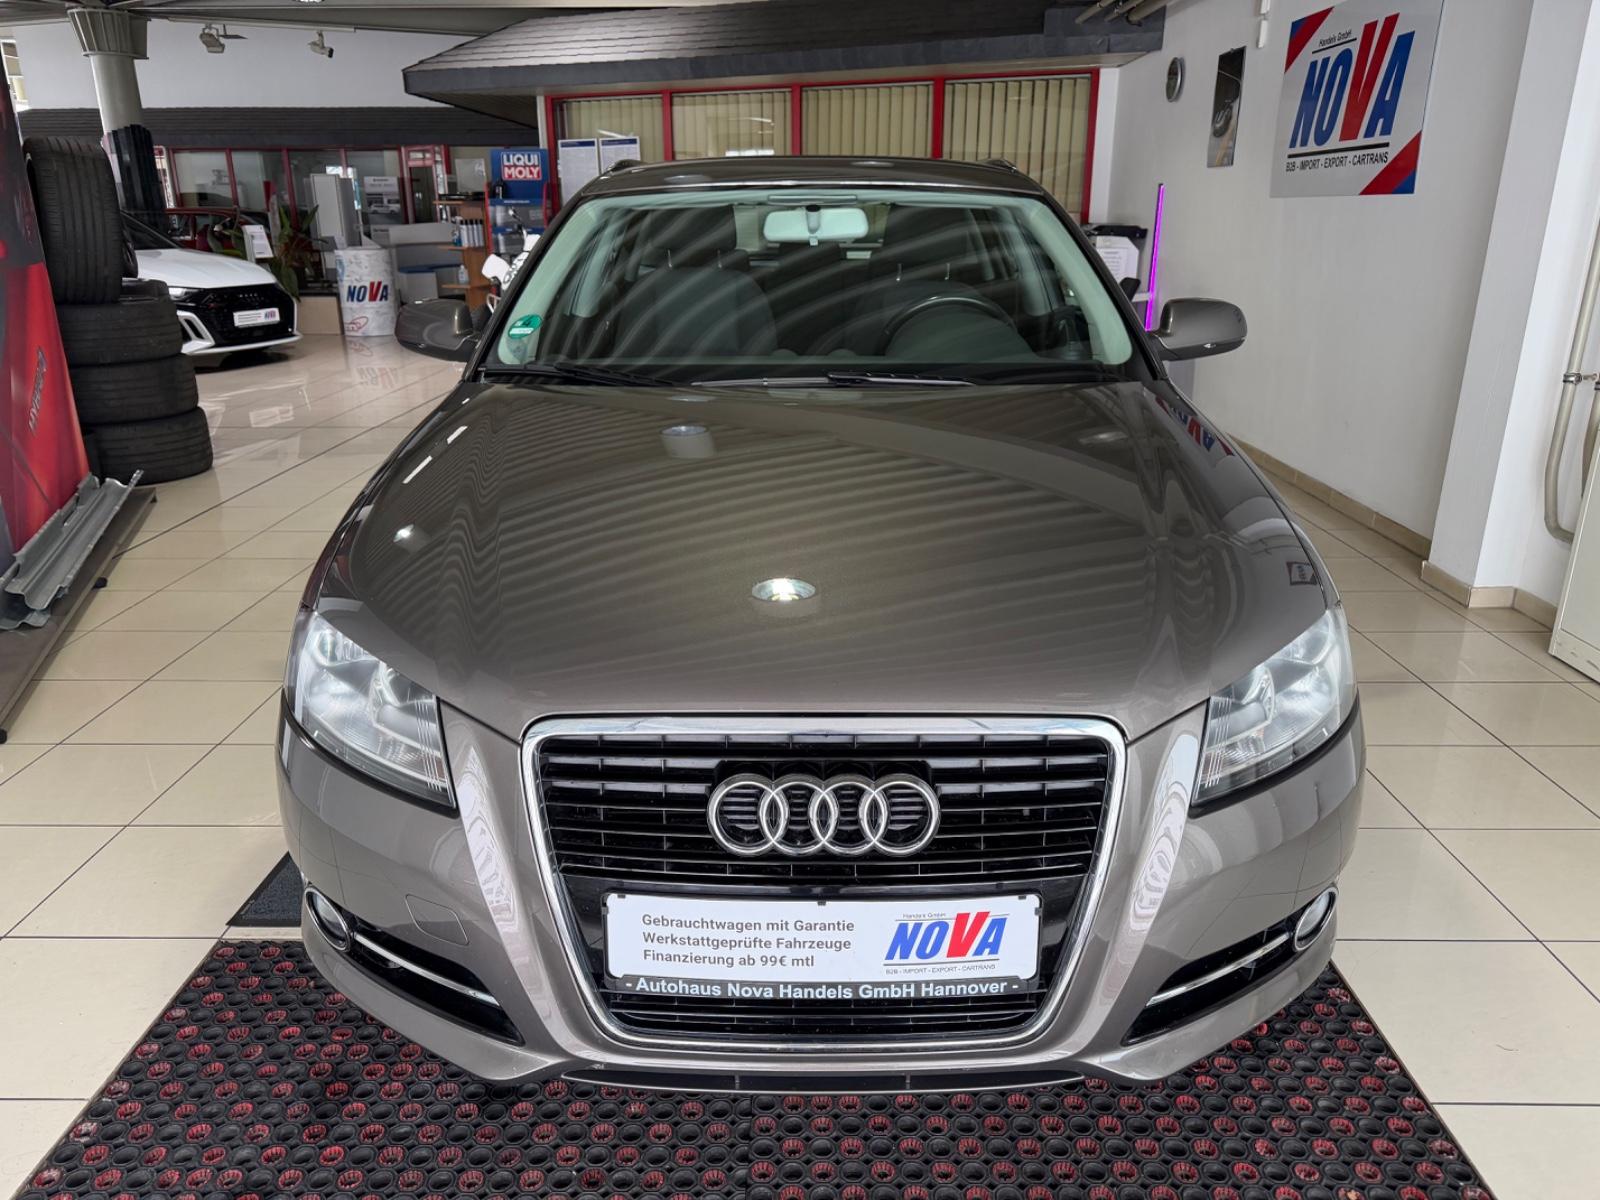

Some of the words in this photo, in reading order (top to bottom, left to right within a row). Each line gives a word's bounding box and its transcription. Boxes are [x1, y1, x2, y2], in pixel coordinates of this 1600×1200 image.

[1289, 12, 1415, 149] NOVA
[503, 153, 538, 166] LIQUI
[1299, 158, 1320, 170] IMPORT
[1323, 155, 1348, 169] EXPORT
[1352, 151, 1389, 166] CARTRANS
[504, 166, 541, 179] MOLY
[346, 280, 389, 303] NOVA
[642, 913, 761, 933] Gebrauchtwagen
[766, 919, 790, 932] mit
[793, 919, 855, 932] Garantie
[643, 931, 772, 950] Werkstattgeprüfte
[776, 937, 852, 952] Fahrzeuge
[885, 911, 1008, 961] NOVA
[643, 949, 734, 968] Finanzierung
[738, 955, 756, 966] ab
[760, 955, 787, 967] 99€
[791, 955, 815, 967] mtl
[636, 977, 721, 996] Autohaus
[727, 983, 774, 998] Nova
[779, 984, 853, 999] Handels
[858, 983, 915, 998] GmbH
[921, 981, 1008, 997] Hannover
